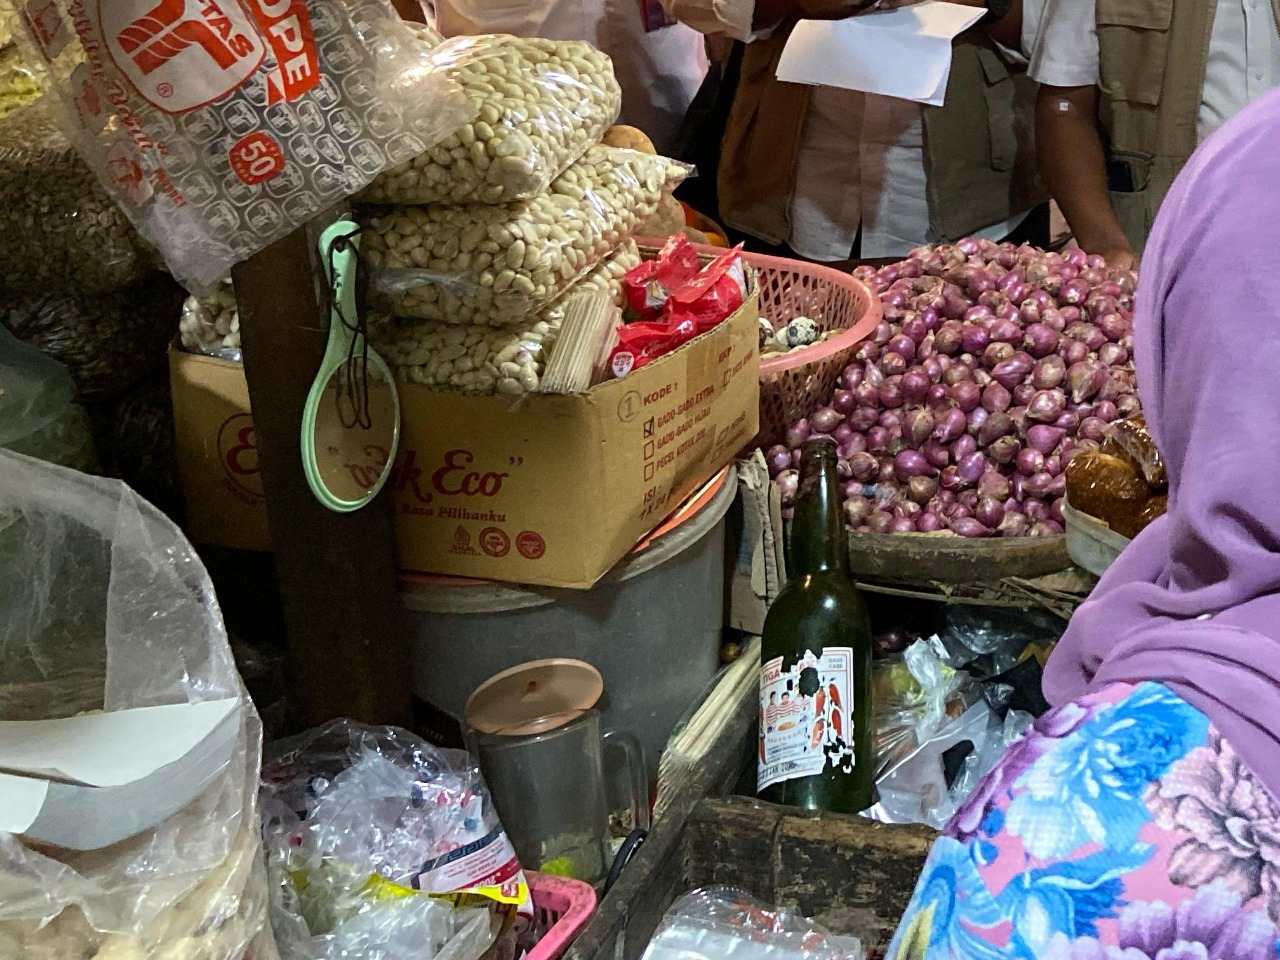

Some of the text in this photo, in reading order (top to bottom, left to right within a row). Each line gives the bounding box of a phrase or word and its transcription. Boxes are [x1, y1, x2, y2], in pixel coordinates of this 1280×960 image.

[240, 140, 277, 177] 50
[643, 384, 672, 406] KODE
[437, 505, 507, 523] Pilihanku
